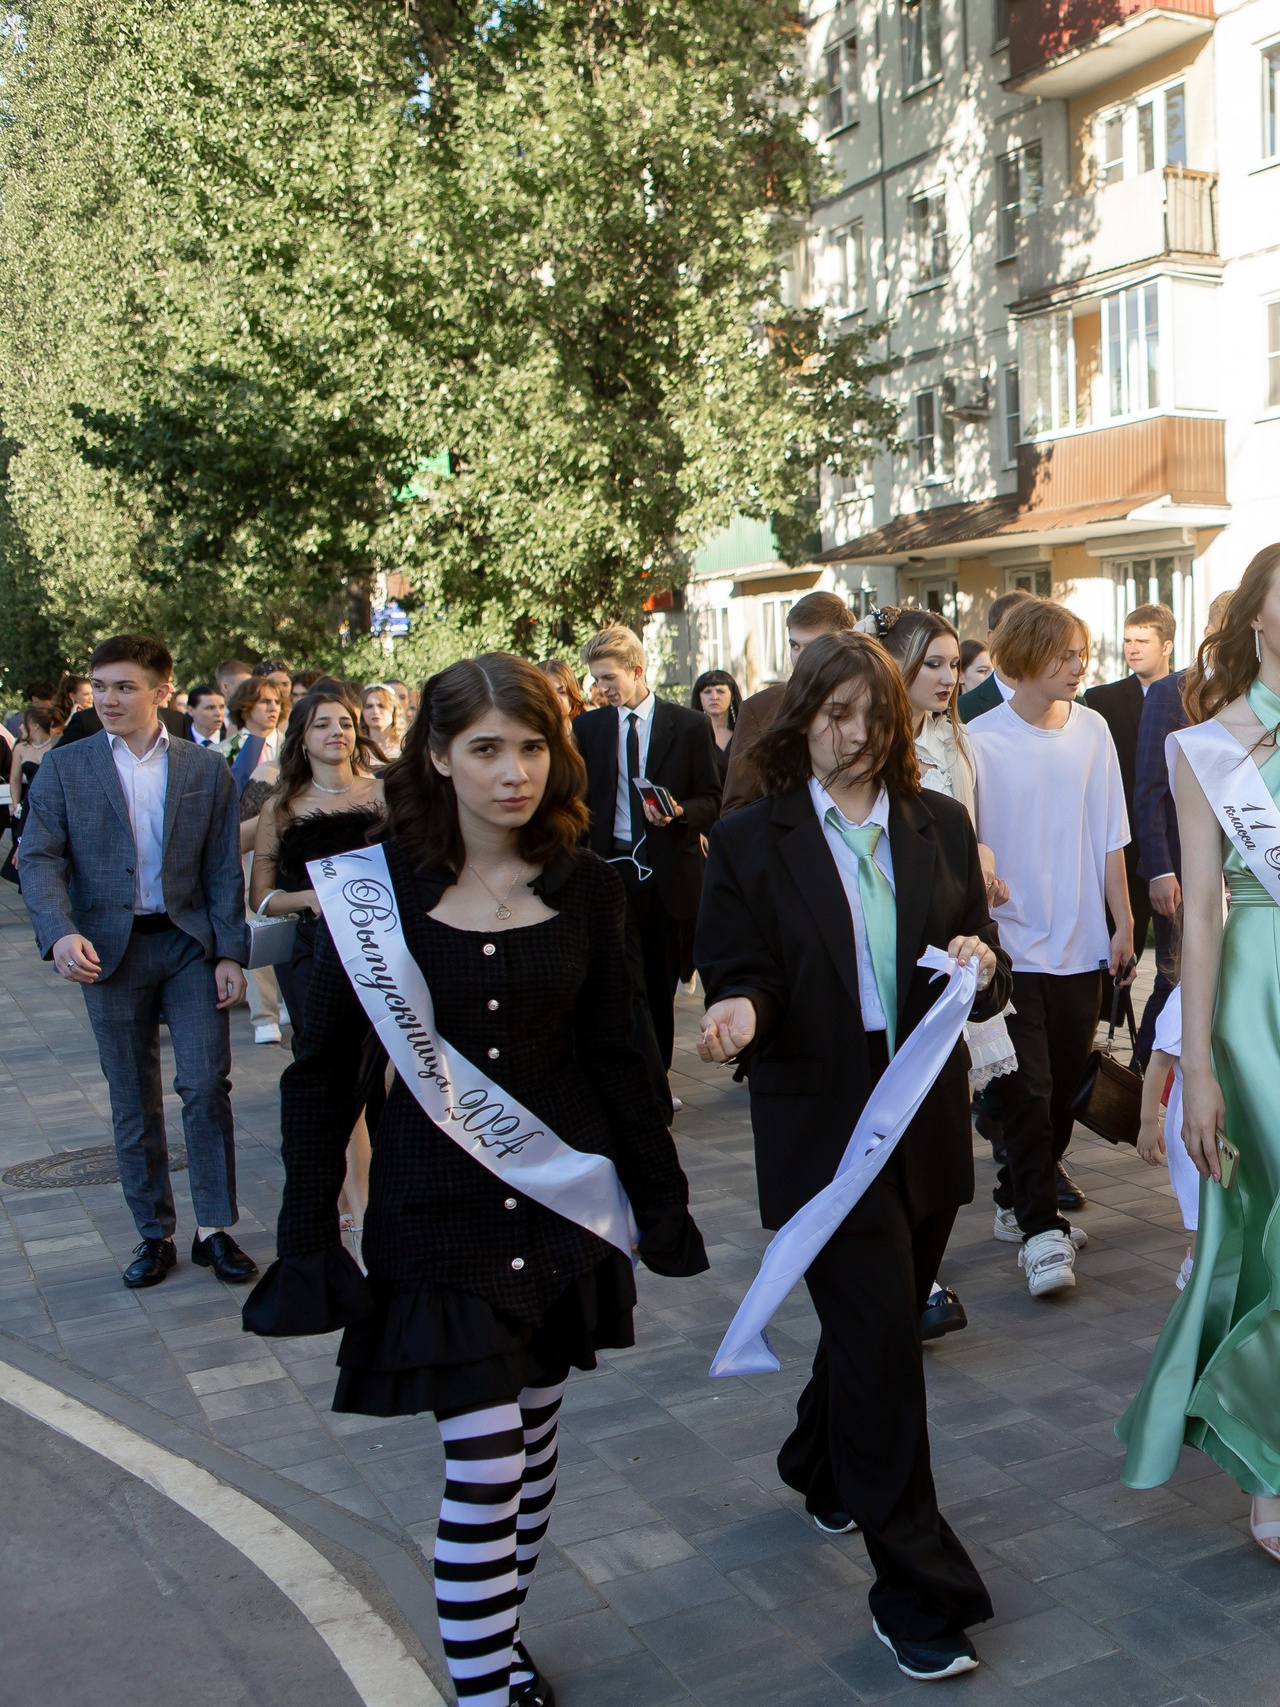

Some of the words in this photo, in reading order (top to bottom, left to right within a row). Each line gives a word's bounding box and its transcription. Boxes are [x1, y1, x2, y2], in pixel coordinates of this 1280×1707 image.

[1223, 806, 1256, 851] класса
[342, 878, 451, 1093] Выпускница
[444, 1089, 544, 1159] 2024
